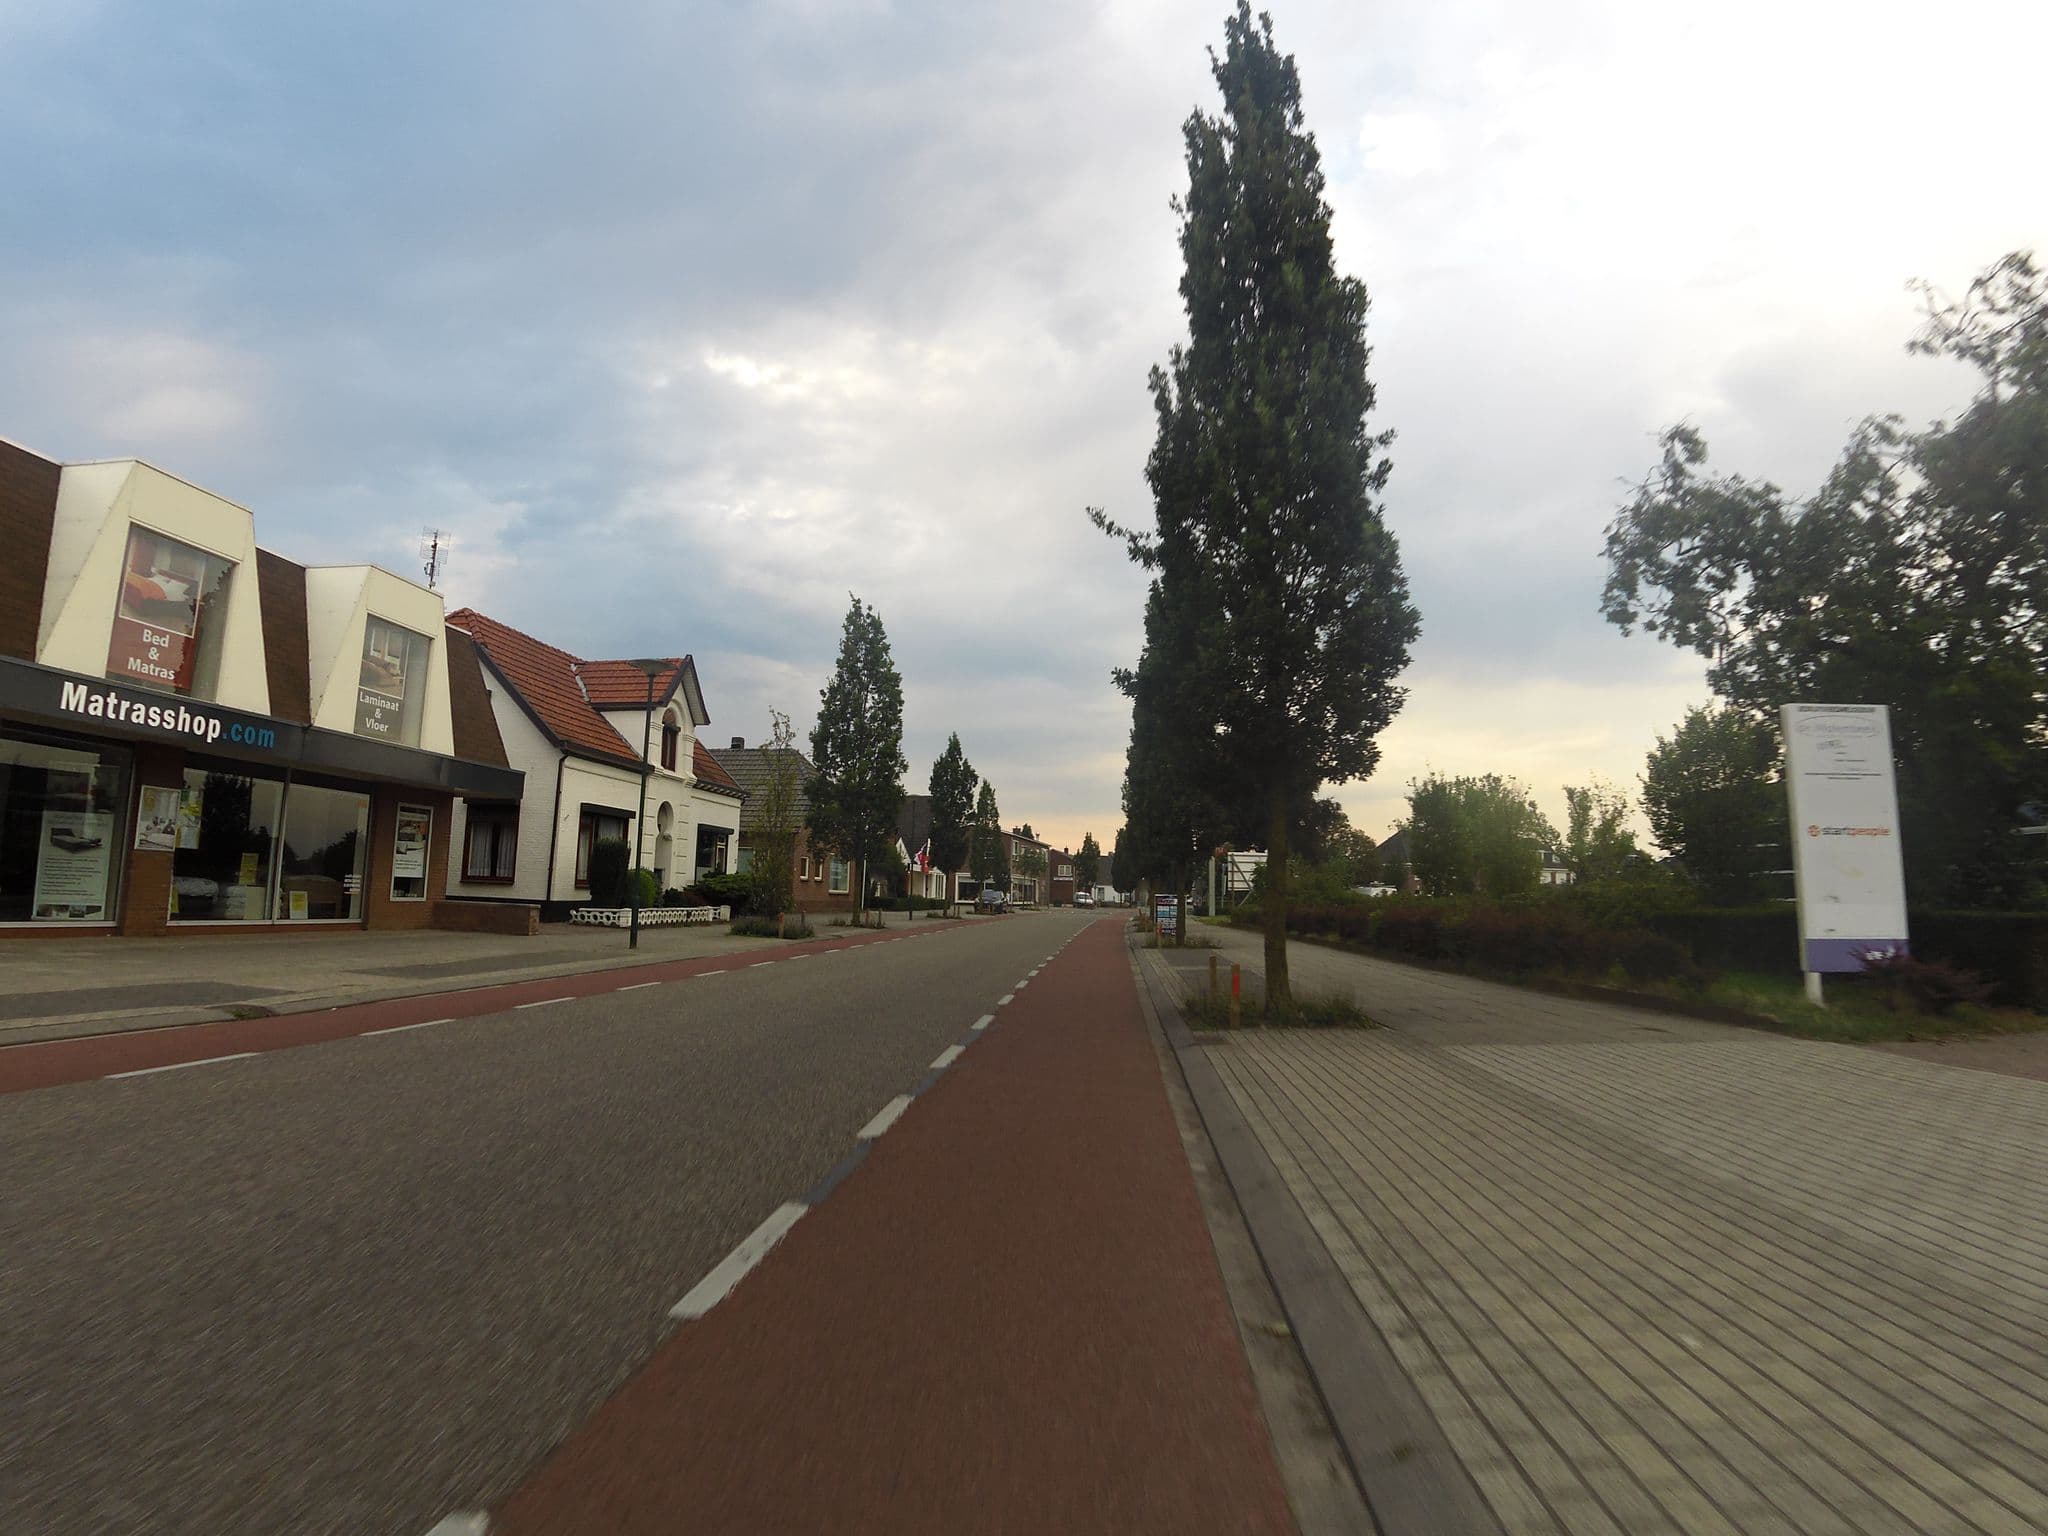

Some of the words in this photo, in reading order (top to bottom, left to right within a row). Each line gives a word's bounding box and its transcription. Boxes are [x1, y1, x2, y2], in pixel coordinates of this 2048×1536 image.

[143, 628, 170, 648] Bed
[148, 646, 160, 661] &
[127, 656, 176, 680] Matras
[359, 691, 400, 712] Laminaat
[59, 680, 275, 748] Matrasshop.com
[374, 707, 382, 719] &
[365, 717, 389, 732] Vloer
